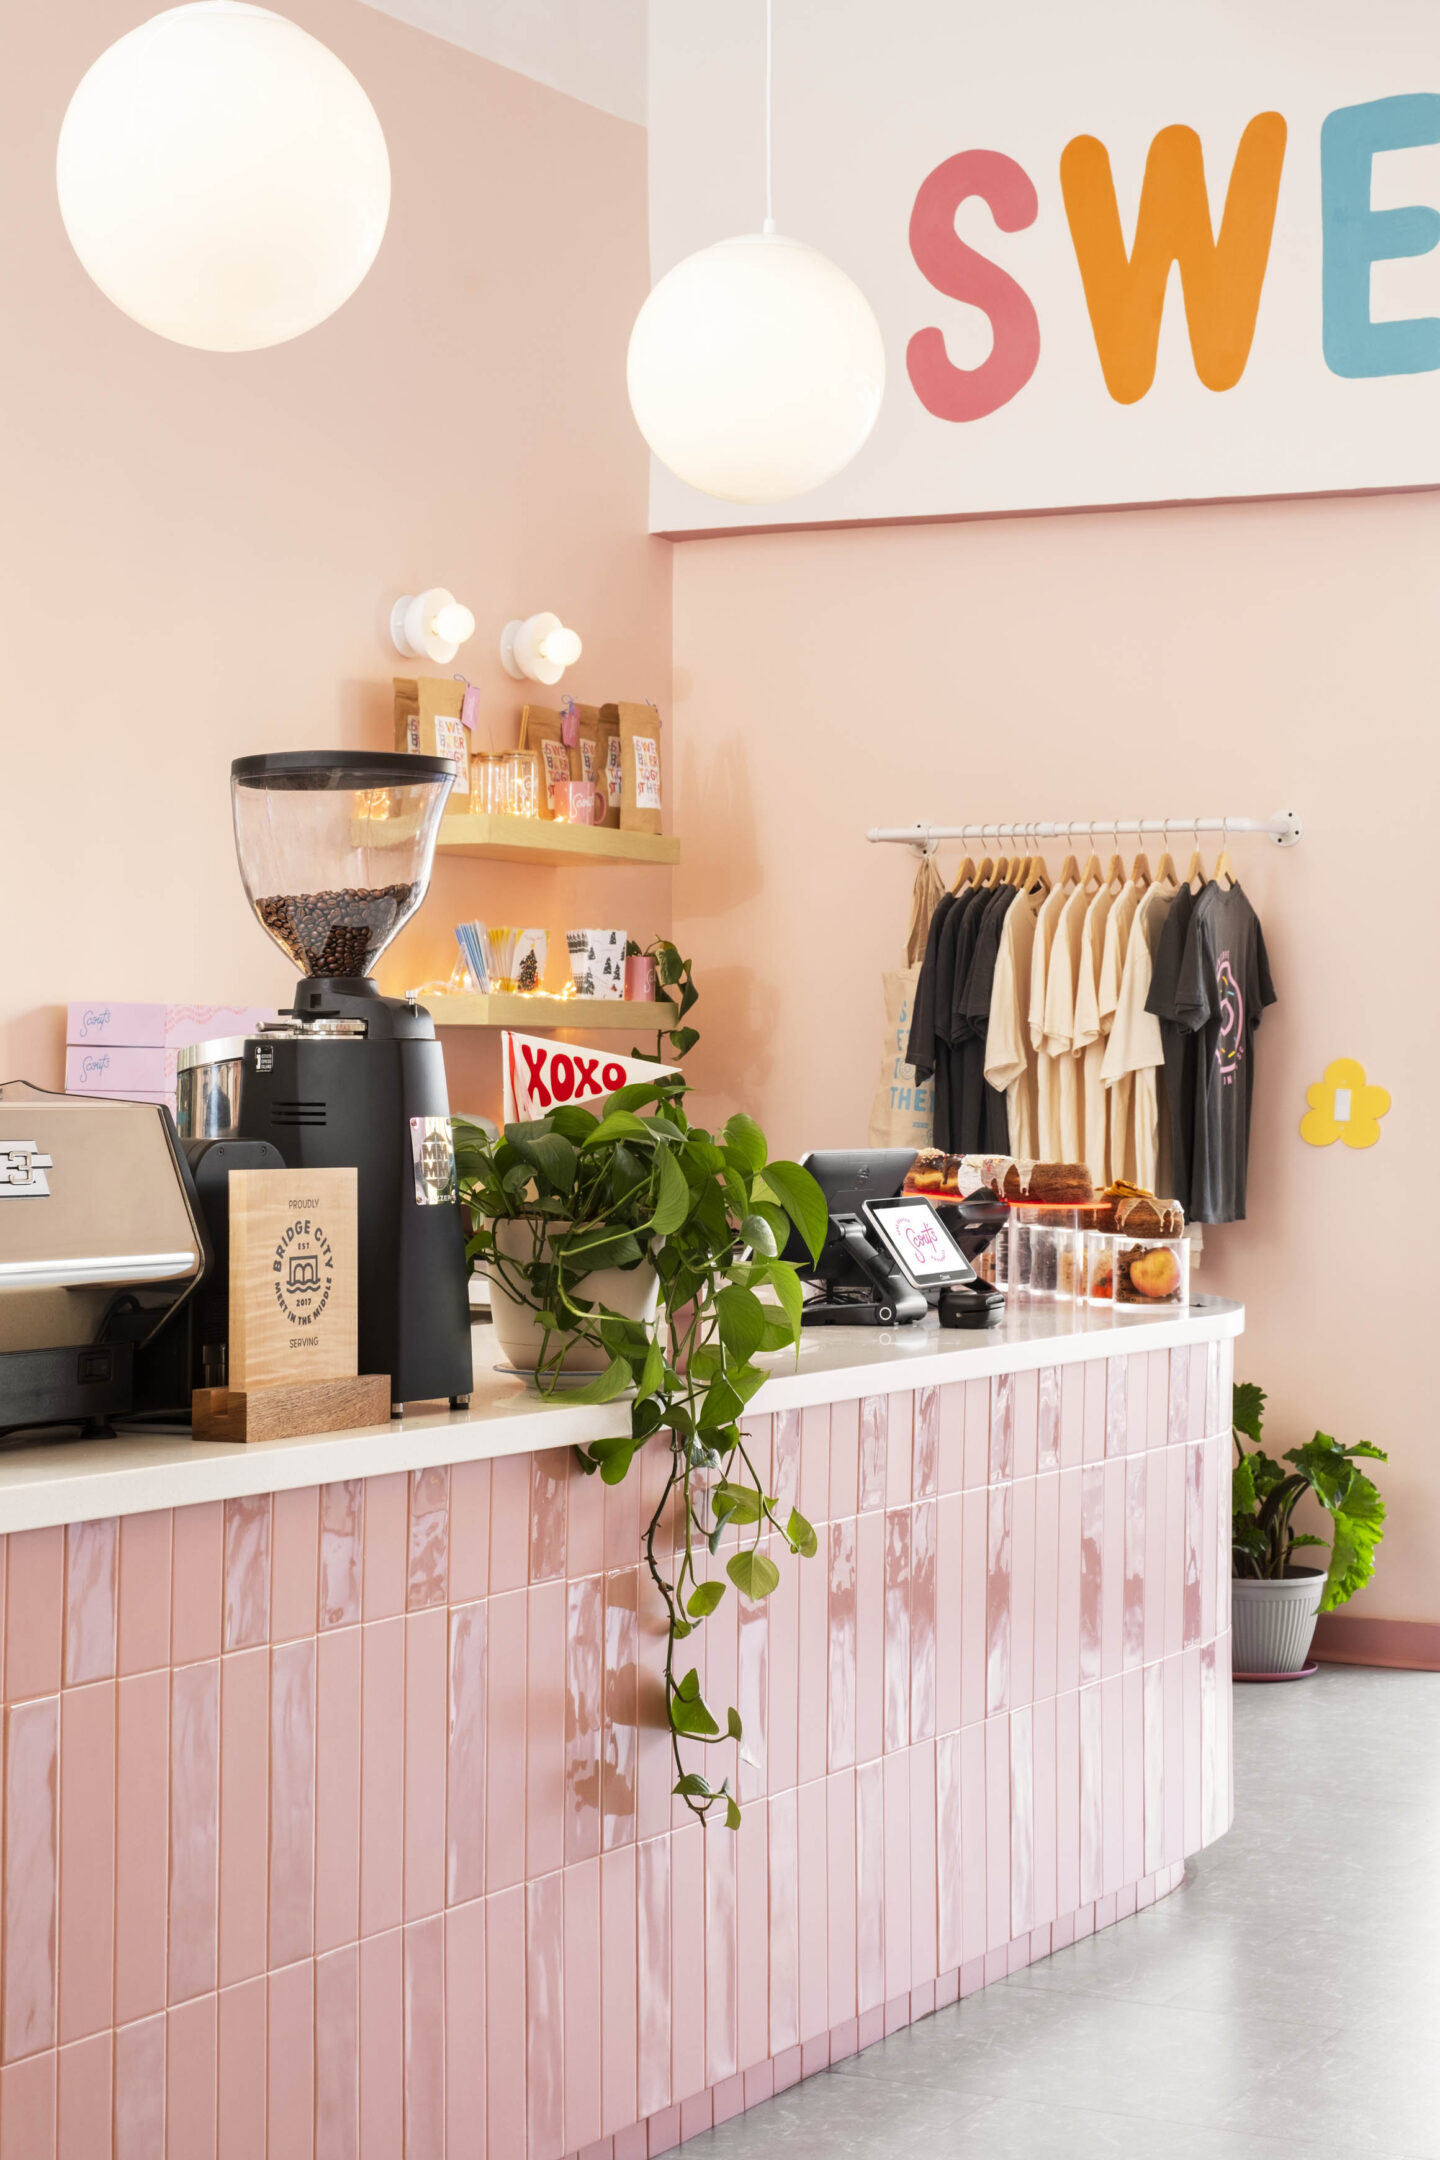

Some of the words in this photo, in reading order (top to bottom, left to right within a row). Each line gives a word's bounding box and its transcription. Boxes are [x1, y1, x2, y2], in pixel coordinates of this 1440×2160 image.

[906, 92, 1440, 423] SWE
[521, 1044, 627, 1107] XOXO
[288, 1199, 320, 1209] PROUDLY
[273, 1220, 311, 1272] BRIDGE
[314, 1227, 334, 1269] CITY
[297, 1242, 310, 1250] EST
[275, 1281, 288, 1313] MEET
[287, 1311, 296, 1324] IN
[298, 1314, 312, 1326] THE
[312, 1277, 332, 1321] MIDDLE
[296, 1298, 312, 1307] 2017
[289, 1336, 319, 1349] SERVING
